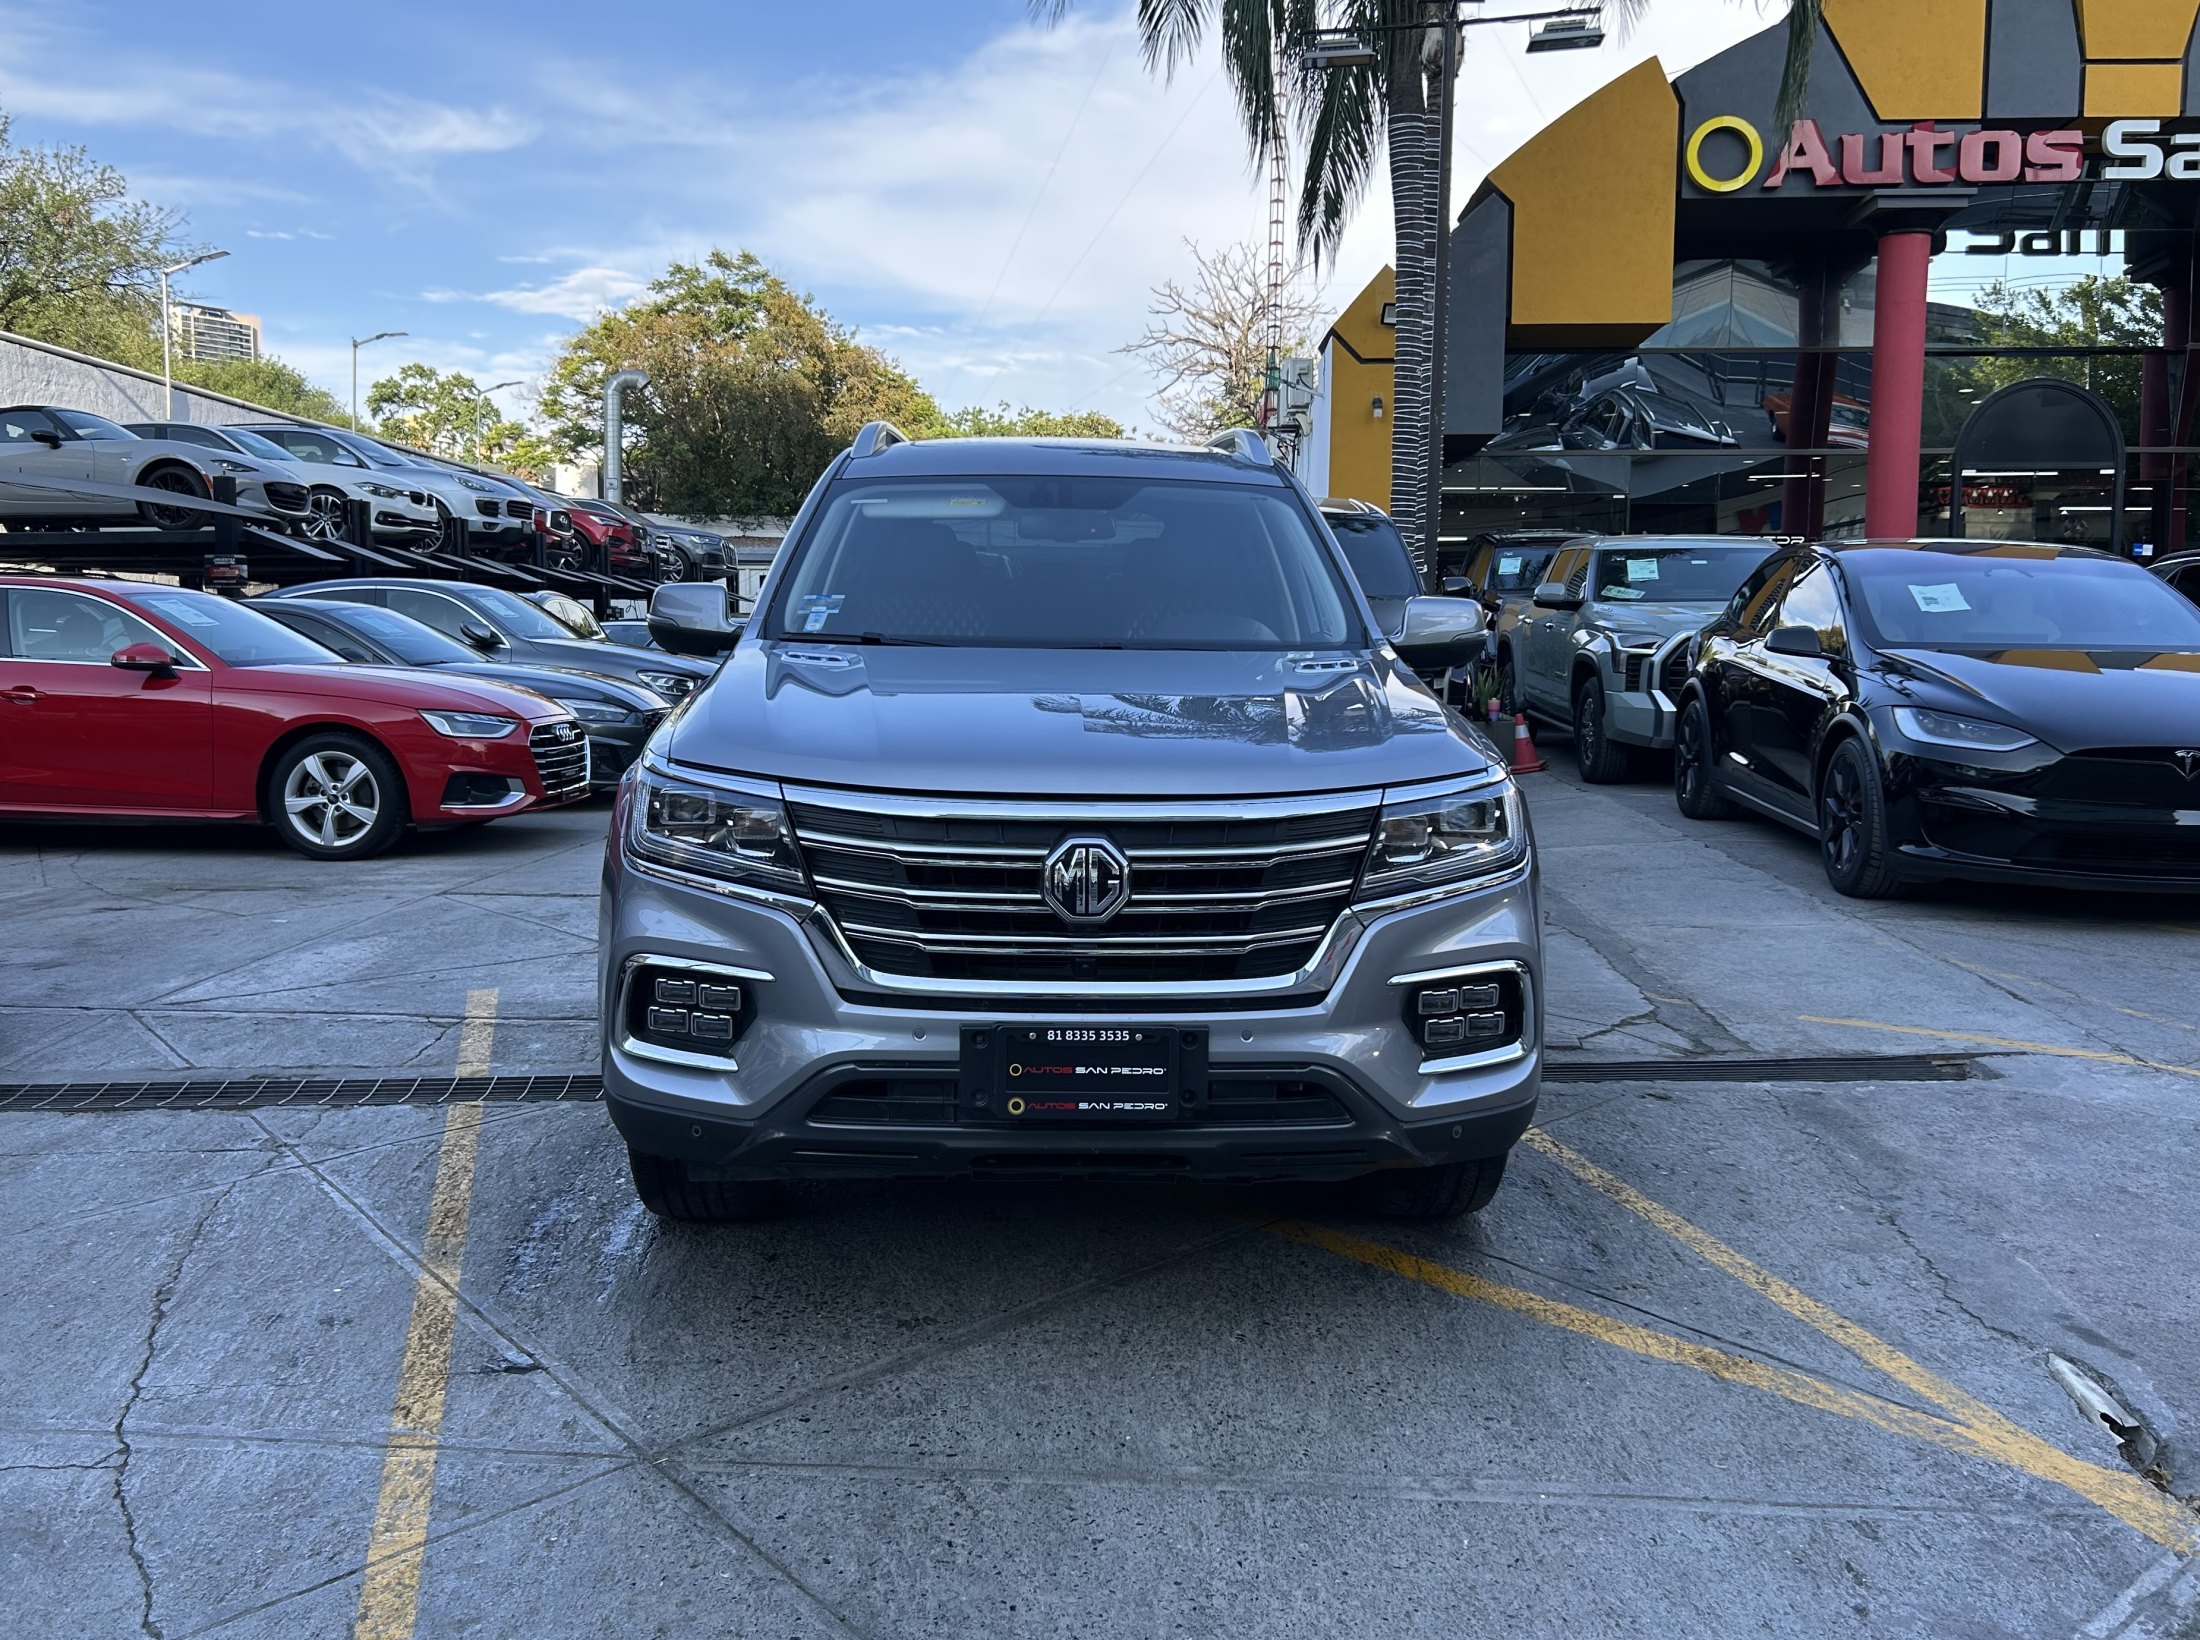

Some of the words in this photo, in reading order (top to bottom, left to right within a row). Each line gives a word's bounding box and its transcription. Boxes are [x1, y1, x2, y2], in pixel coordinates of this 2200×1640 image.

[1763, 119, 2084, 188] Autos
[2101, 119, 2200, 181] Sa
[1054, 848, 1120, 914] MG
[1047, 1030, 1062, 1041] 81
[1065, 1030, 1096, 1041] 8335
[1099, 1030, 1130, 1041] 3535
[1023, 1066, 1073, 1074] AUTOS
[1075, 1066, 1108, 1074] SAN
[1027, 1102, 1077, 1110] AUTOS
[1078, 1102, 1110, 1110] SAN
